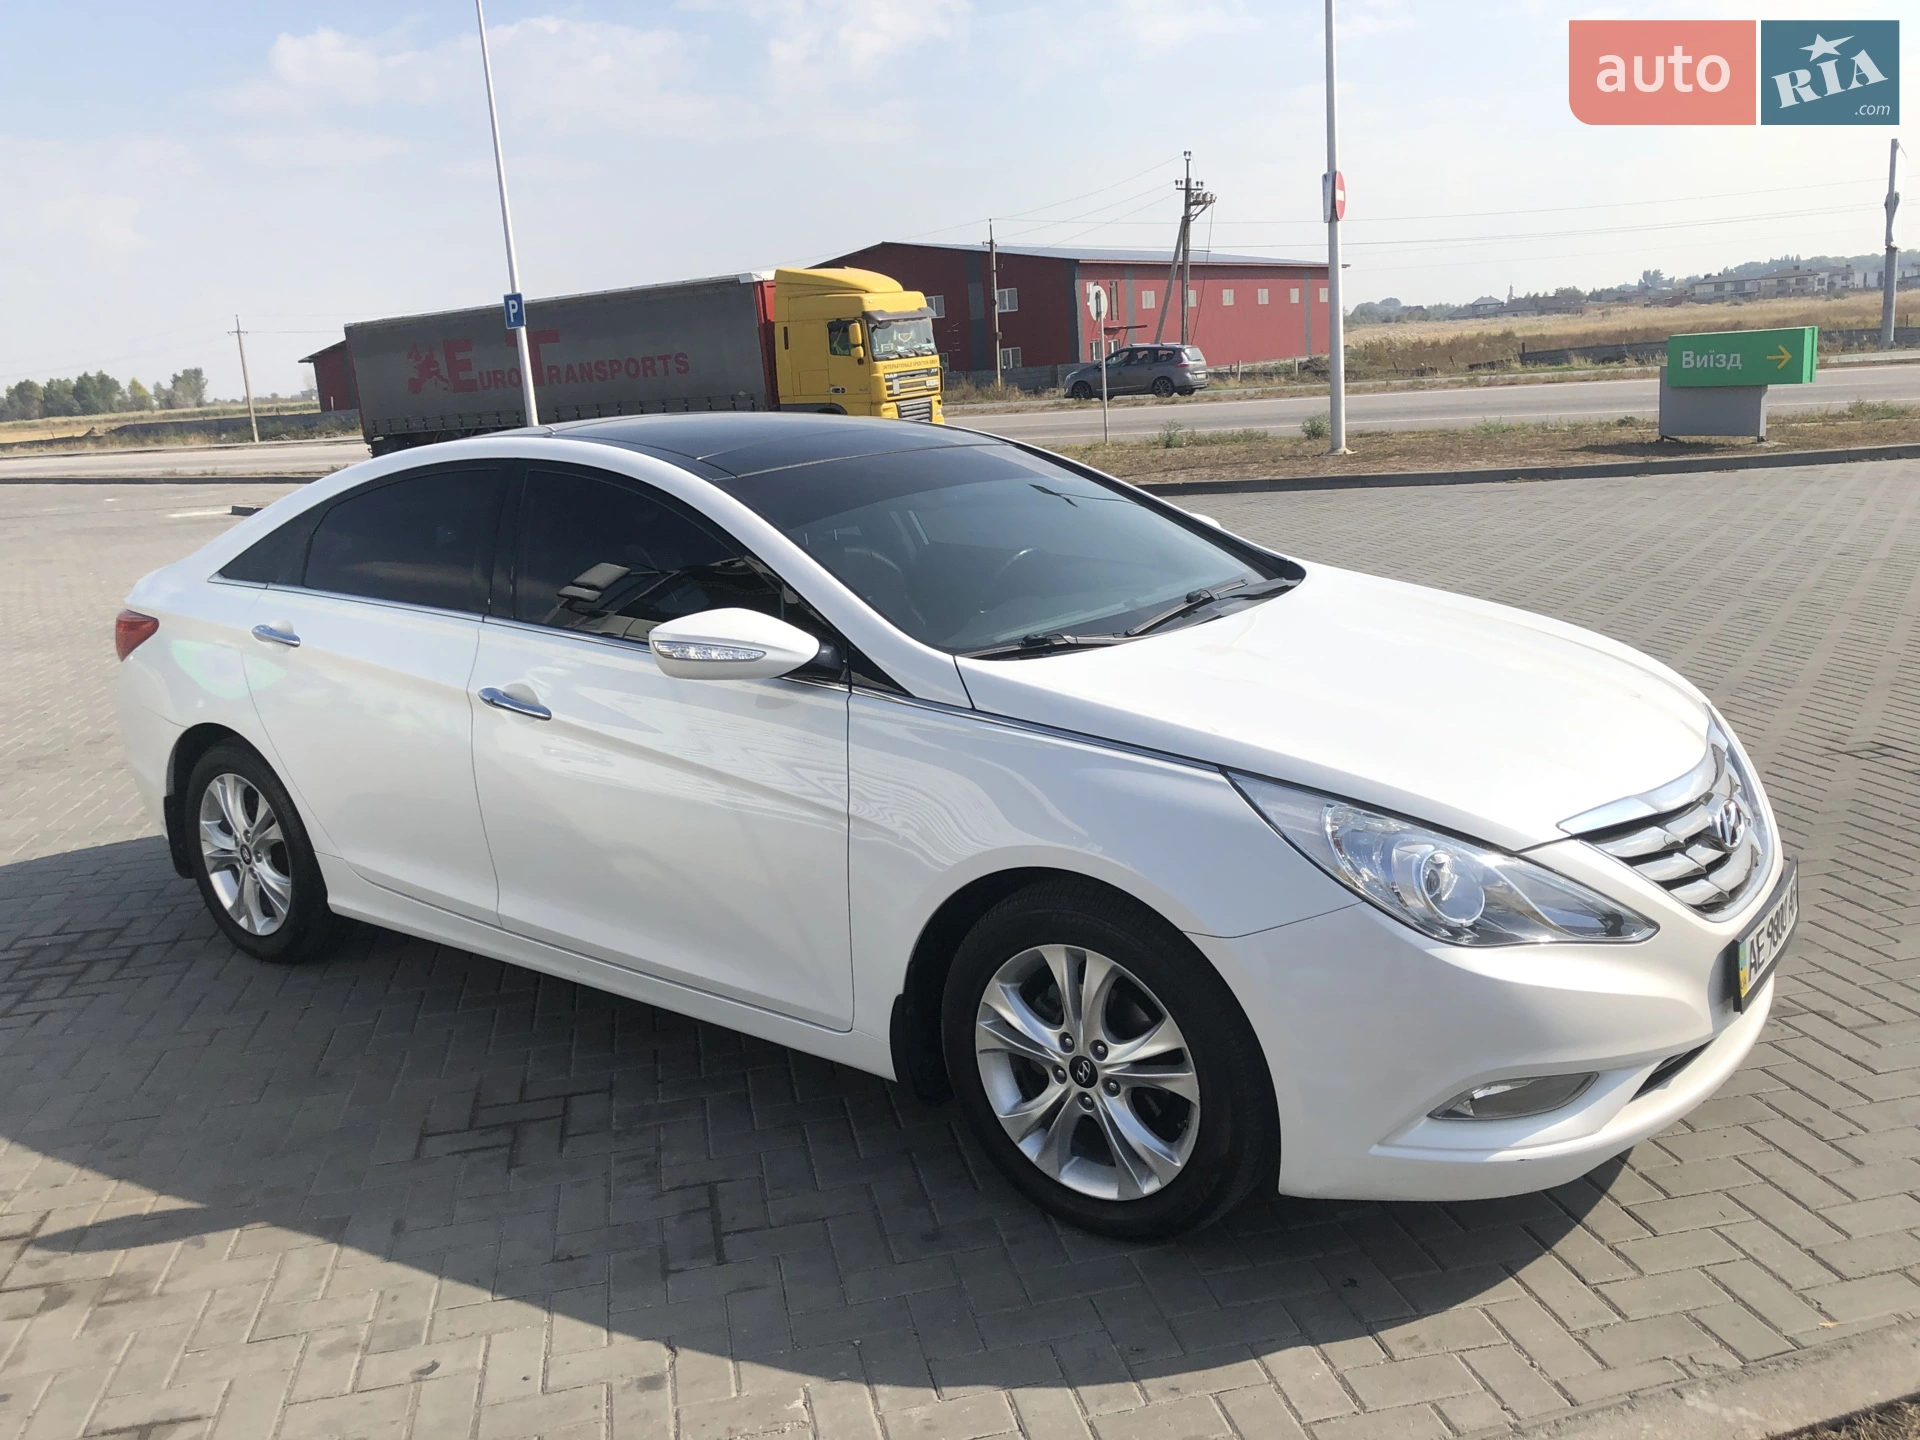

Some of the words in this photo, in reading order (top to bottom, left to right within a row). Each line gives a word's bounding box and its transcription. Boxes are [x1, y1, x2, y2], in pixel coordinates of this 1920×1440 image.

[508, 299, 518, 323] P
[1682, 349, 1742, 370] Виїзд
[1748, 926, 1765, 982] AE
[1767, 894, 1788, 958] 9800
